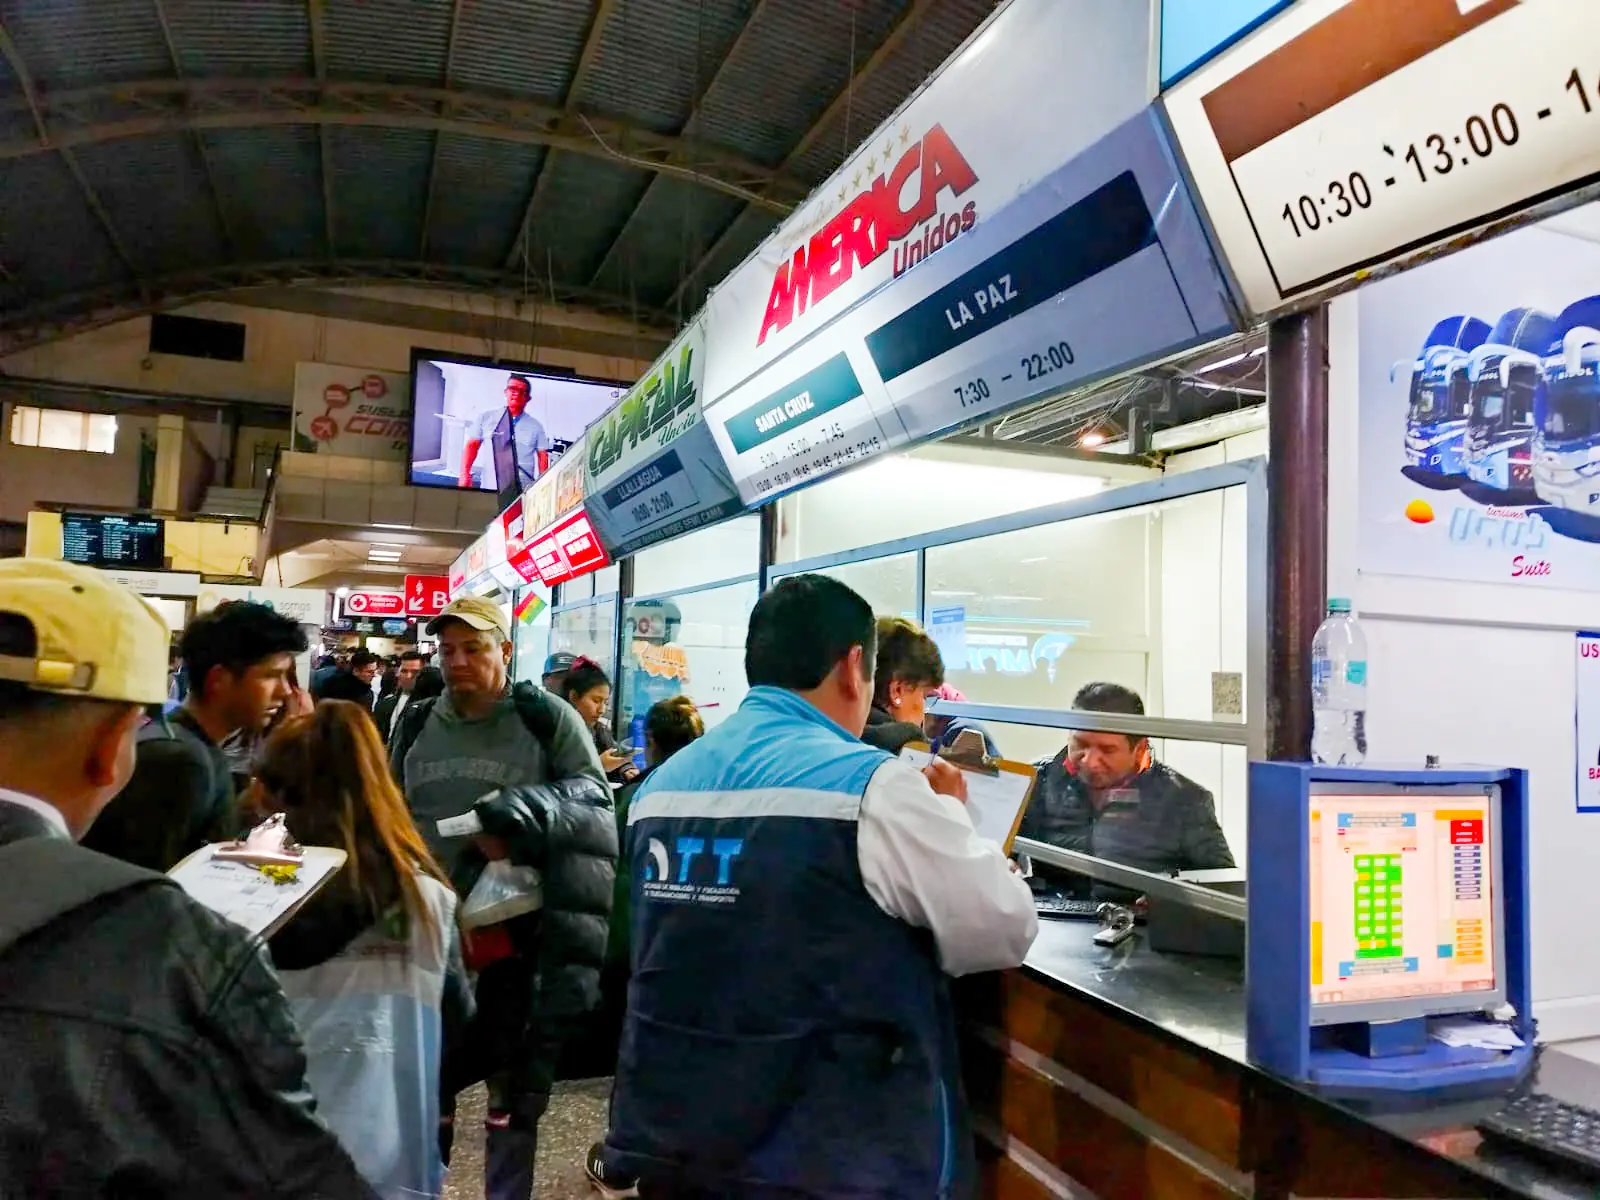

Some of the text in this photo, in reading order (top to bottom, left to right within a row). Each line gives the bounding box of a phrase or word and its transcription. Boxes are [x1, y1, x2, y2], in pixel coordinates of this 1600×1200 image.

[1281, 171, 1372, 238] 10:30
[1405, 102, 1520, 183] 13:00
[1564, 67, 1600, 114] 1
[756, 121, 980, 348] AMERICA
[892, 200, 976, 280] Unidos
[944, 273, 1019, 331] LA PAZ
[588, 341, 698, 477] CAPITAL
[953, 377, 991, 408] 7:30
[1021, 341, 1075, 381] 22:00
[754, 390, 815, 433] SANTA CRUZ
[1511, 555, 1552, 577] Suite
